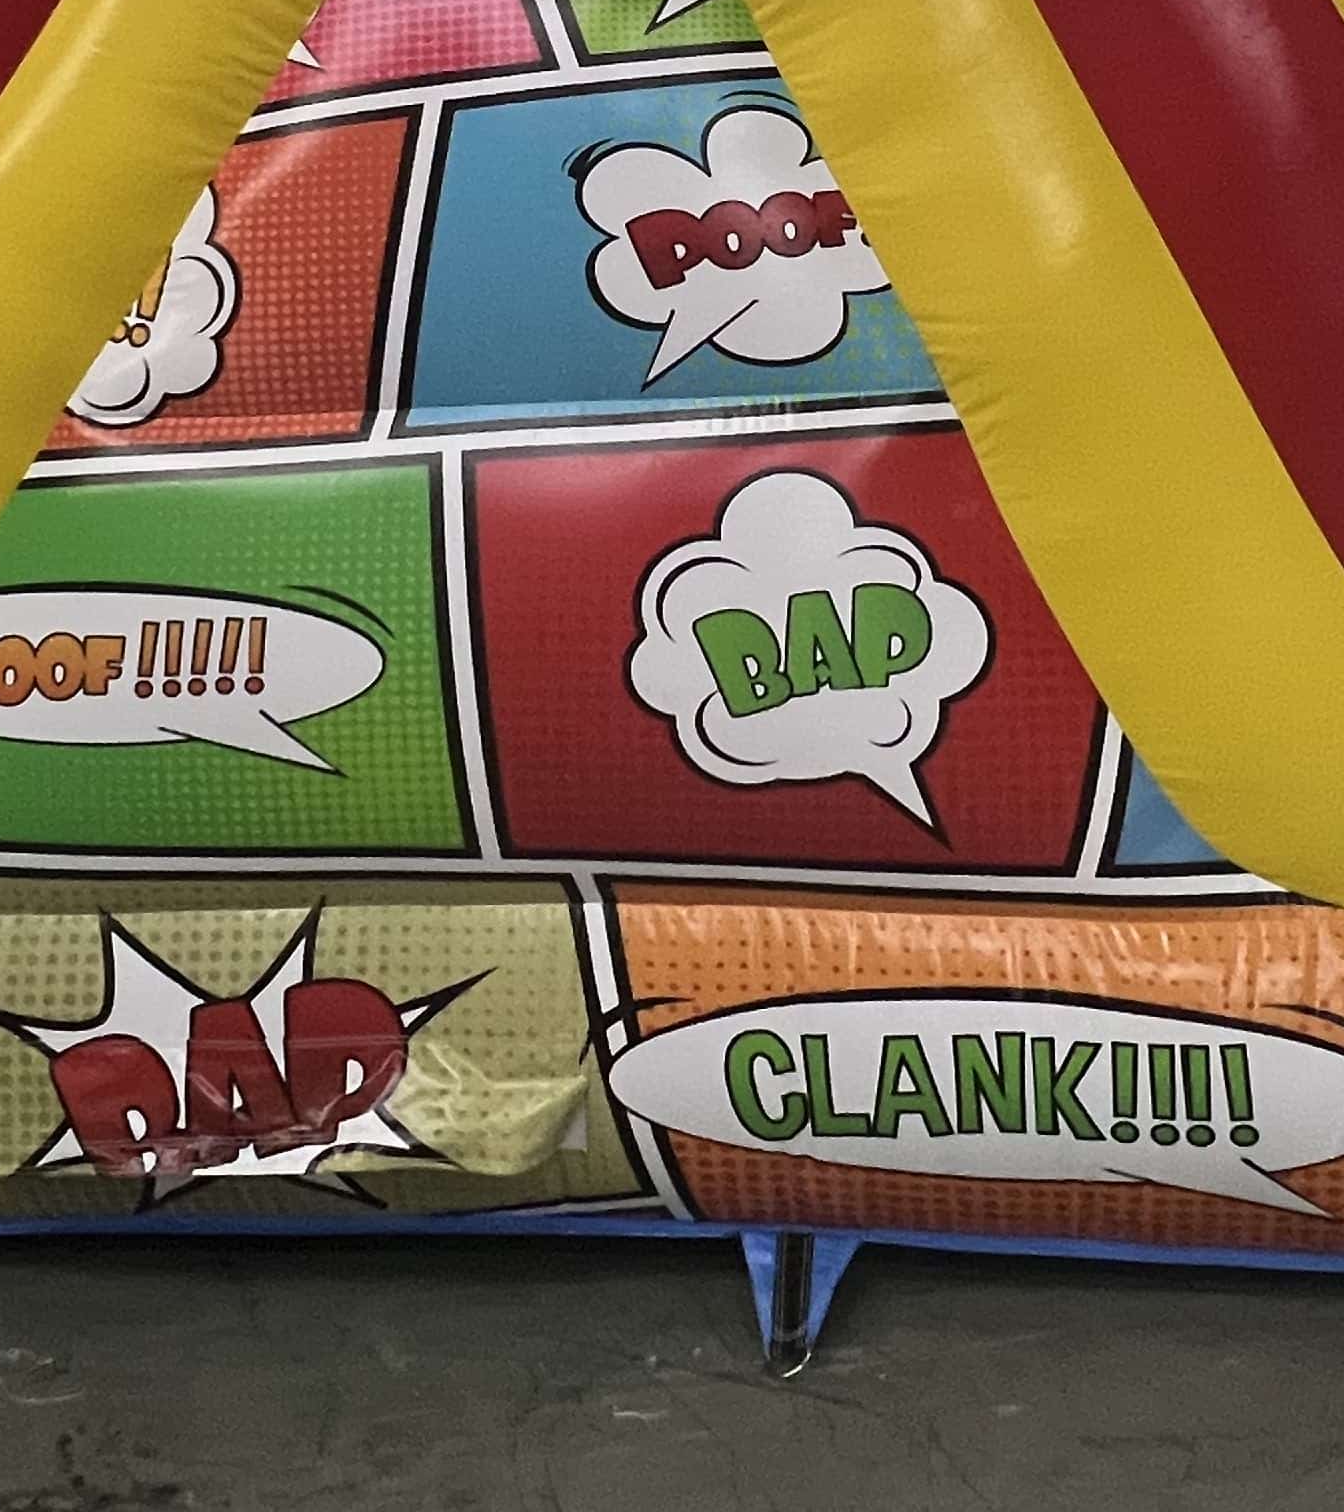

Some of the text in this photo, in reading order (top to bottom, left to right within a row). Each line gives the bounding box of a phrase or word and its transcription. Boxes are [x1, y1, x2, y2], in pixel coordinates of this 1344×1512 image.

[624, 189, 870, 290] POOF
[692, 582, 933, 718] BAP
[724, 1028, 1260, 1149] CLANK!!!!
